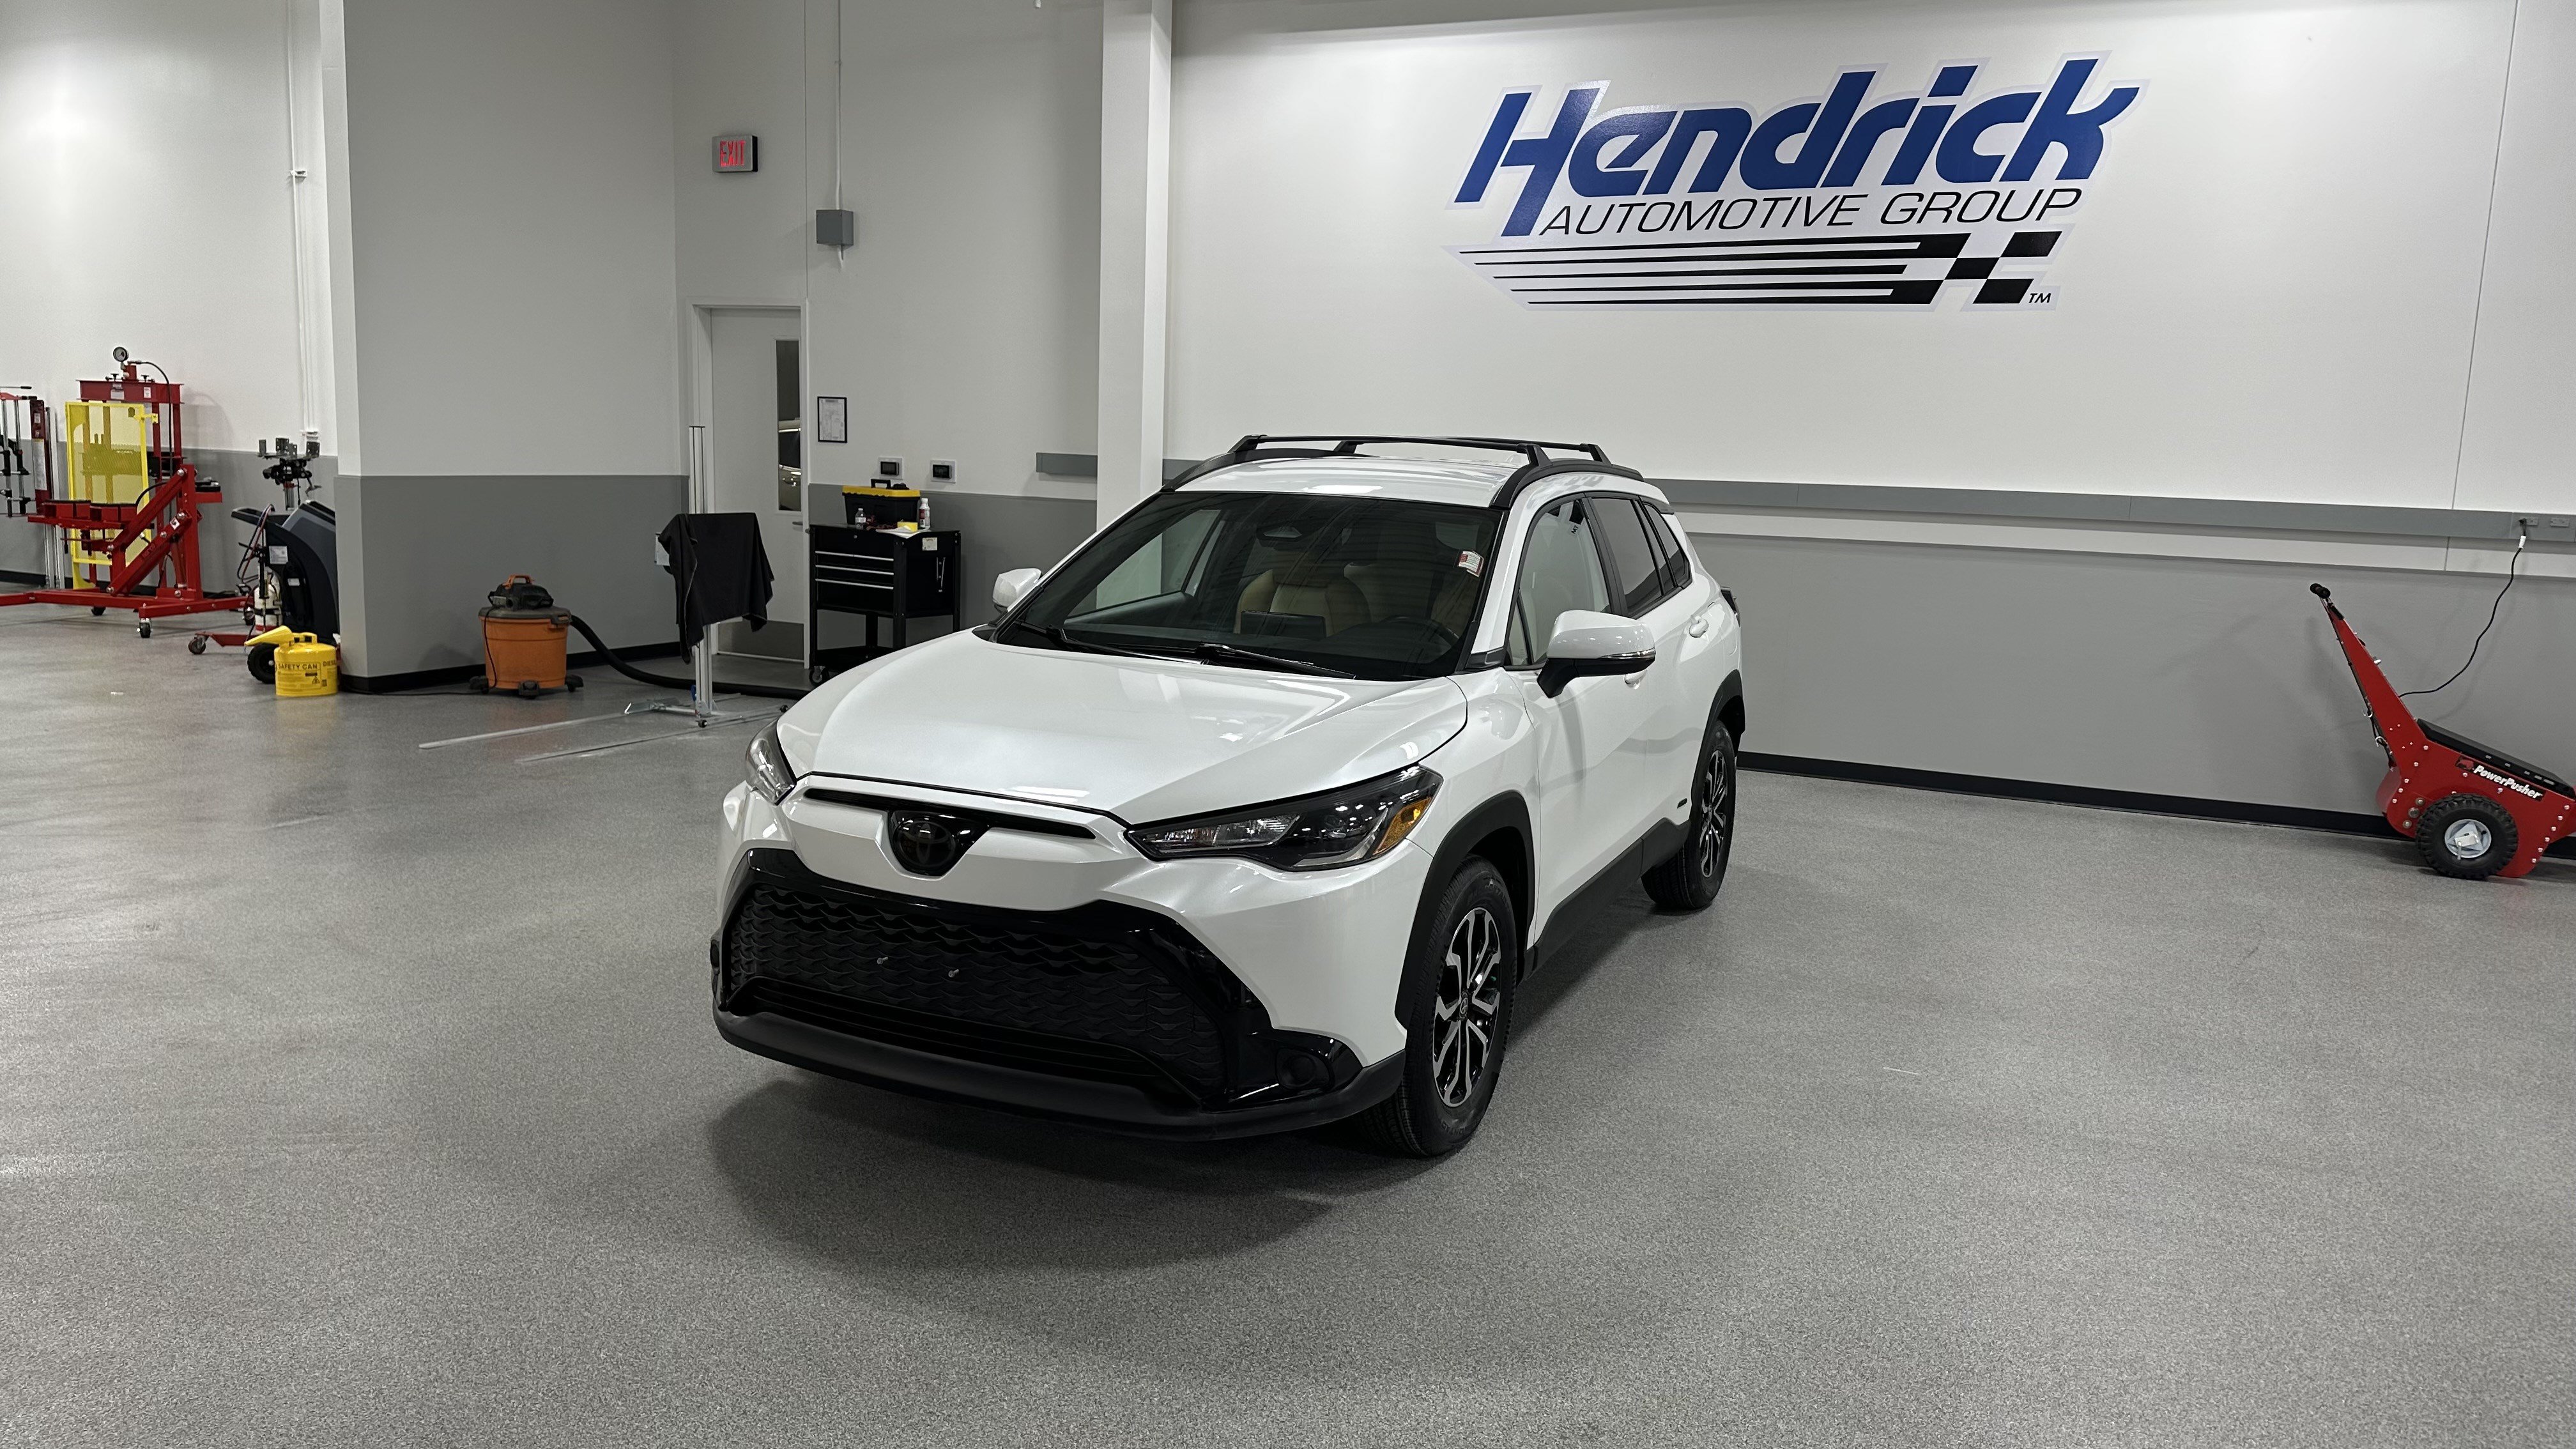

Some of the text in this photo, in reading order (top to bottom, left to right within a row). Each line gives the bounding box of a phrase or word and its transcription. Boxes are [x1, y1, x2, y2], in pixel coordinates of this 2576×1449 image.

[720, 140, 746, 166] EXIT
[1454, 58, 2140, 237] Hendrick
[1538, 188, 2082, 236] AUTOMOTIVE GROUP
[2028, 293, 2051, 303] TM
[2472, 765, 2542, 799] PowerPusher
